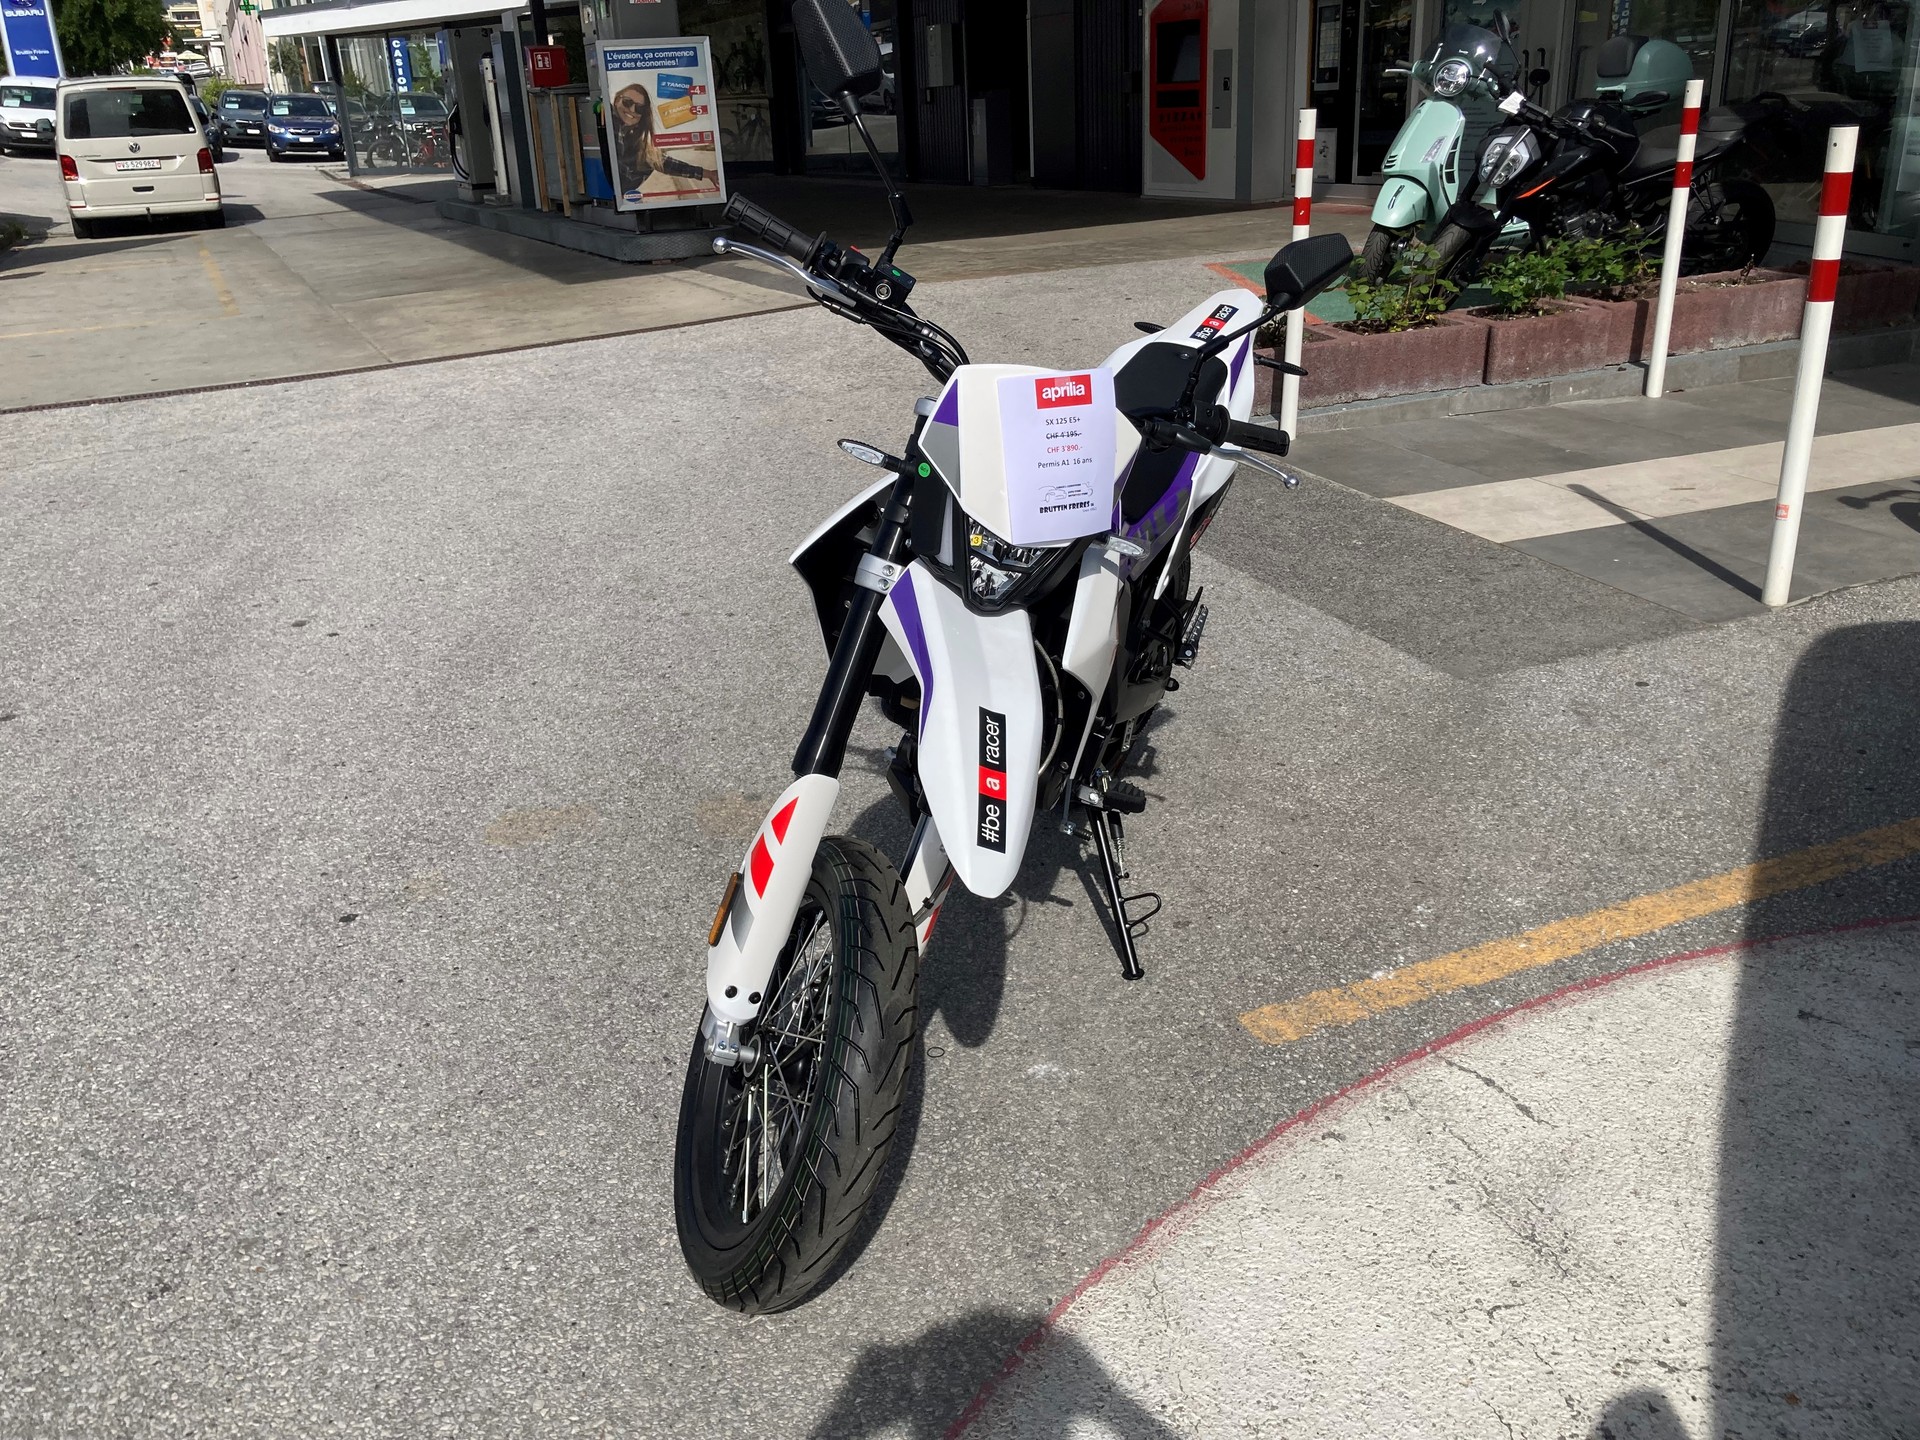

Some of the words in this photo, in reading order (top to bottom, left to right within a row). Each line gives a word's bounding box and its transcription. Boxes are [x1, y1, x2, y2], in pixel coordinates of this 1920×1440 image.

[606, 52, 643, 60] L'évasion,
[644, 52, 653, 60] ça
[654, 50, 694, 58] commence
[608, 62, 620, 70] par
[622, 60, 636, 68] des
[636, 58, 679, 68] économies!
[1042, 382, 1085, 402] aprilia
[1038, 460, 1060, 468] Permis
[1040, 504, 1068, 514] BRUTTIN
[1068, 500, 1090, 510] FRERES
[986, 716, 1000, 764] racer
[986, 777, 1000, 790] a
[981, 804, 1000, 842] #be
